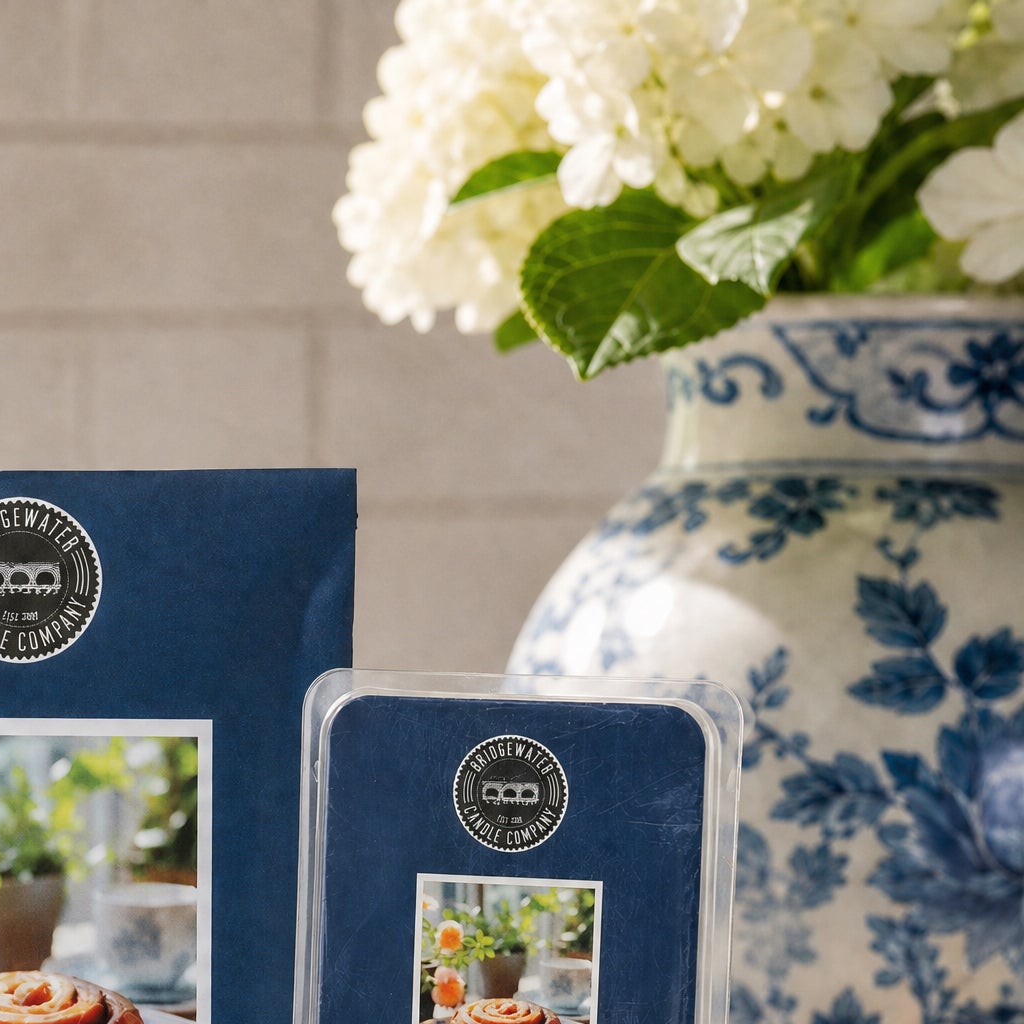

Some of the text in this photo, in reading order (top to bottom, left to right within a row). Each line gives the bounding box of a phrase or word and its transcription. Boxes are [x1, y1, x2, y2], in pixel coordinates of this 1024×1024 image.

[18, 596, 86, 651] COMPANY
[464, 805, 556, 845] CANDLE COMPANY
